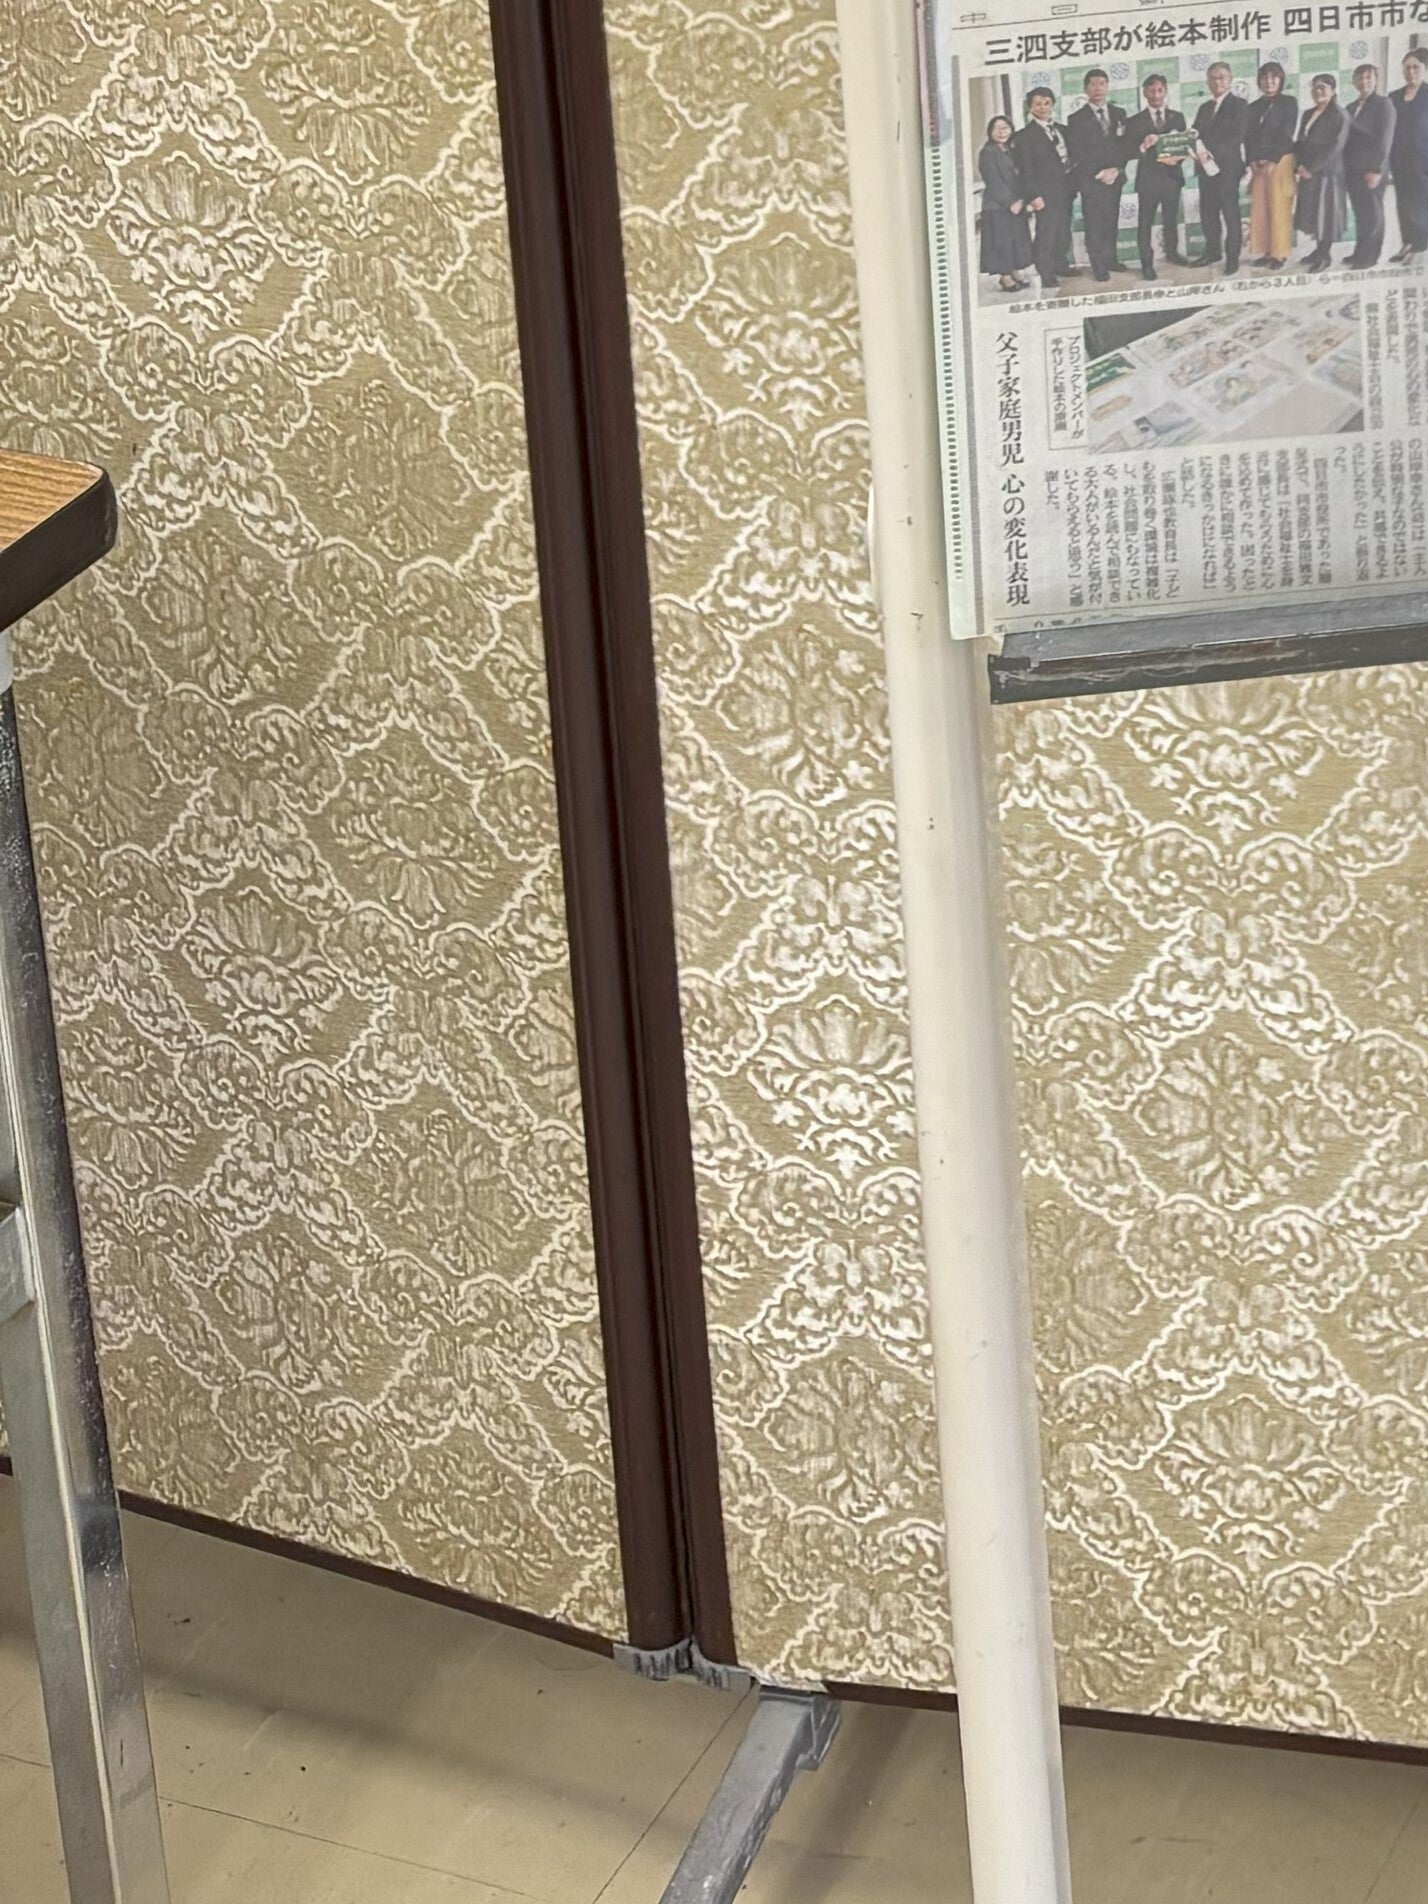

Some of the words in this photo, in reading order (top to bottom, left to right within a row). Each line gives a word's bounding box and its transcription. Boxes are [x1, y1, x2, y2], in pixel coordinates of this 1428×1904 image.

[984, 10, 1272, 67] 三泗支部が絵本制作
[995, 331, 1025, 468] 父子家庭男児
[1000, 473, 1031, 608] 心の変化表現
